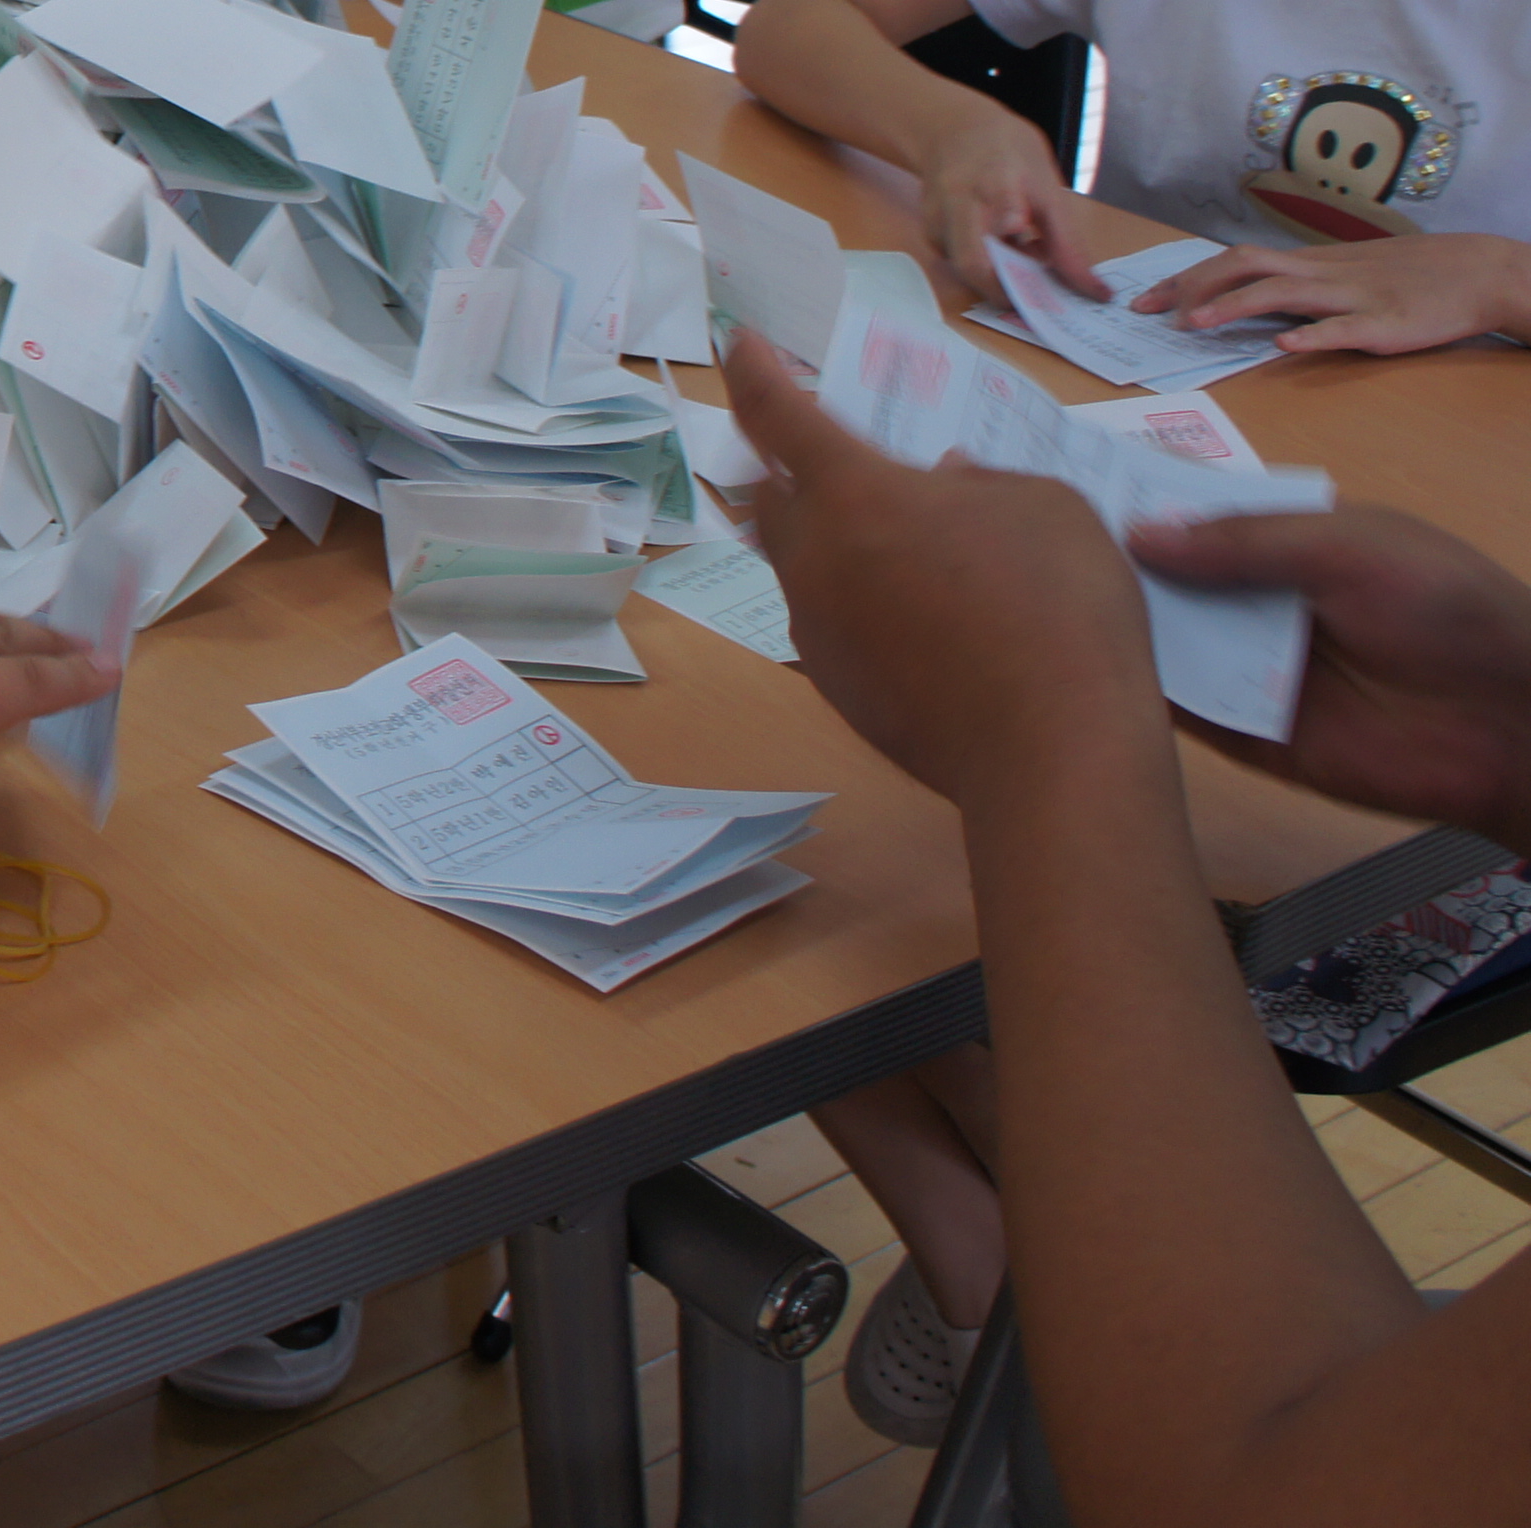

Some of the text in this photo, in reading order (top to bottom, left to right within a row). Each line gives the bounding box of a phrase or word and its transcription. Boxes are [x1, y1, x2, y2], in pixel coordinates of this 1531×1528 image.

[395, 775, 471, 809] 5학년2반
[410, 835, 430, 851] 2
[430, 806, 508, 843] 5학년1반
